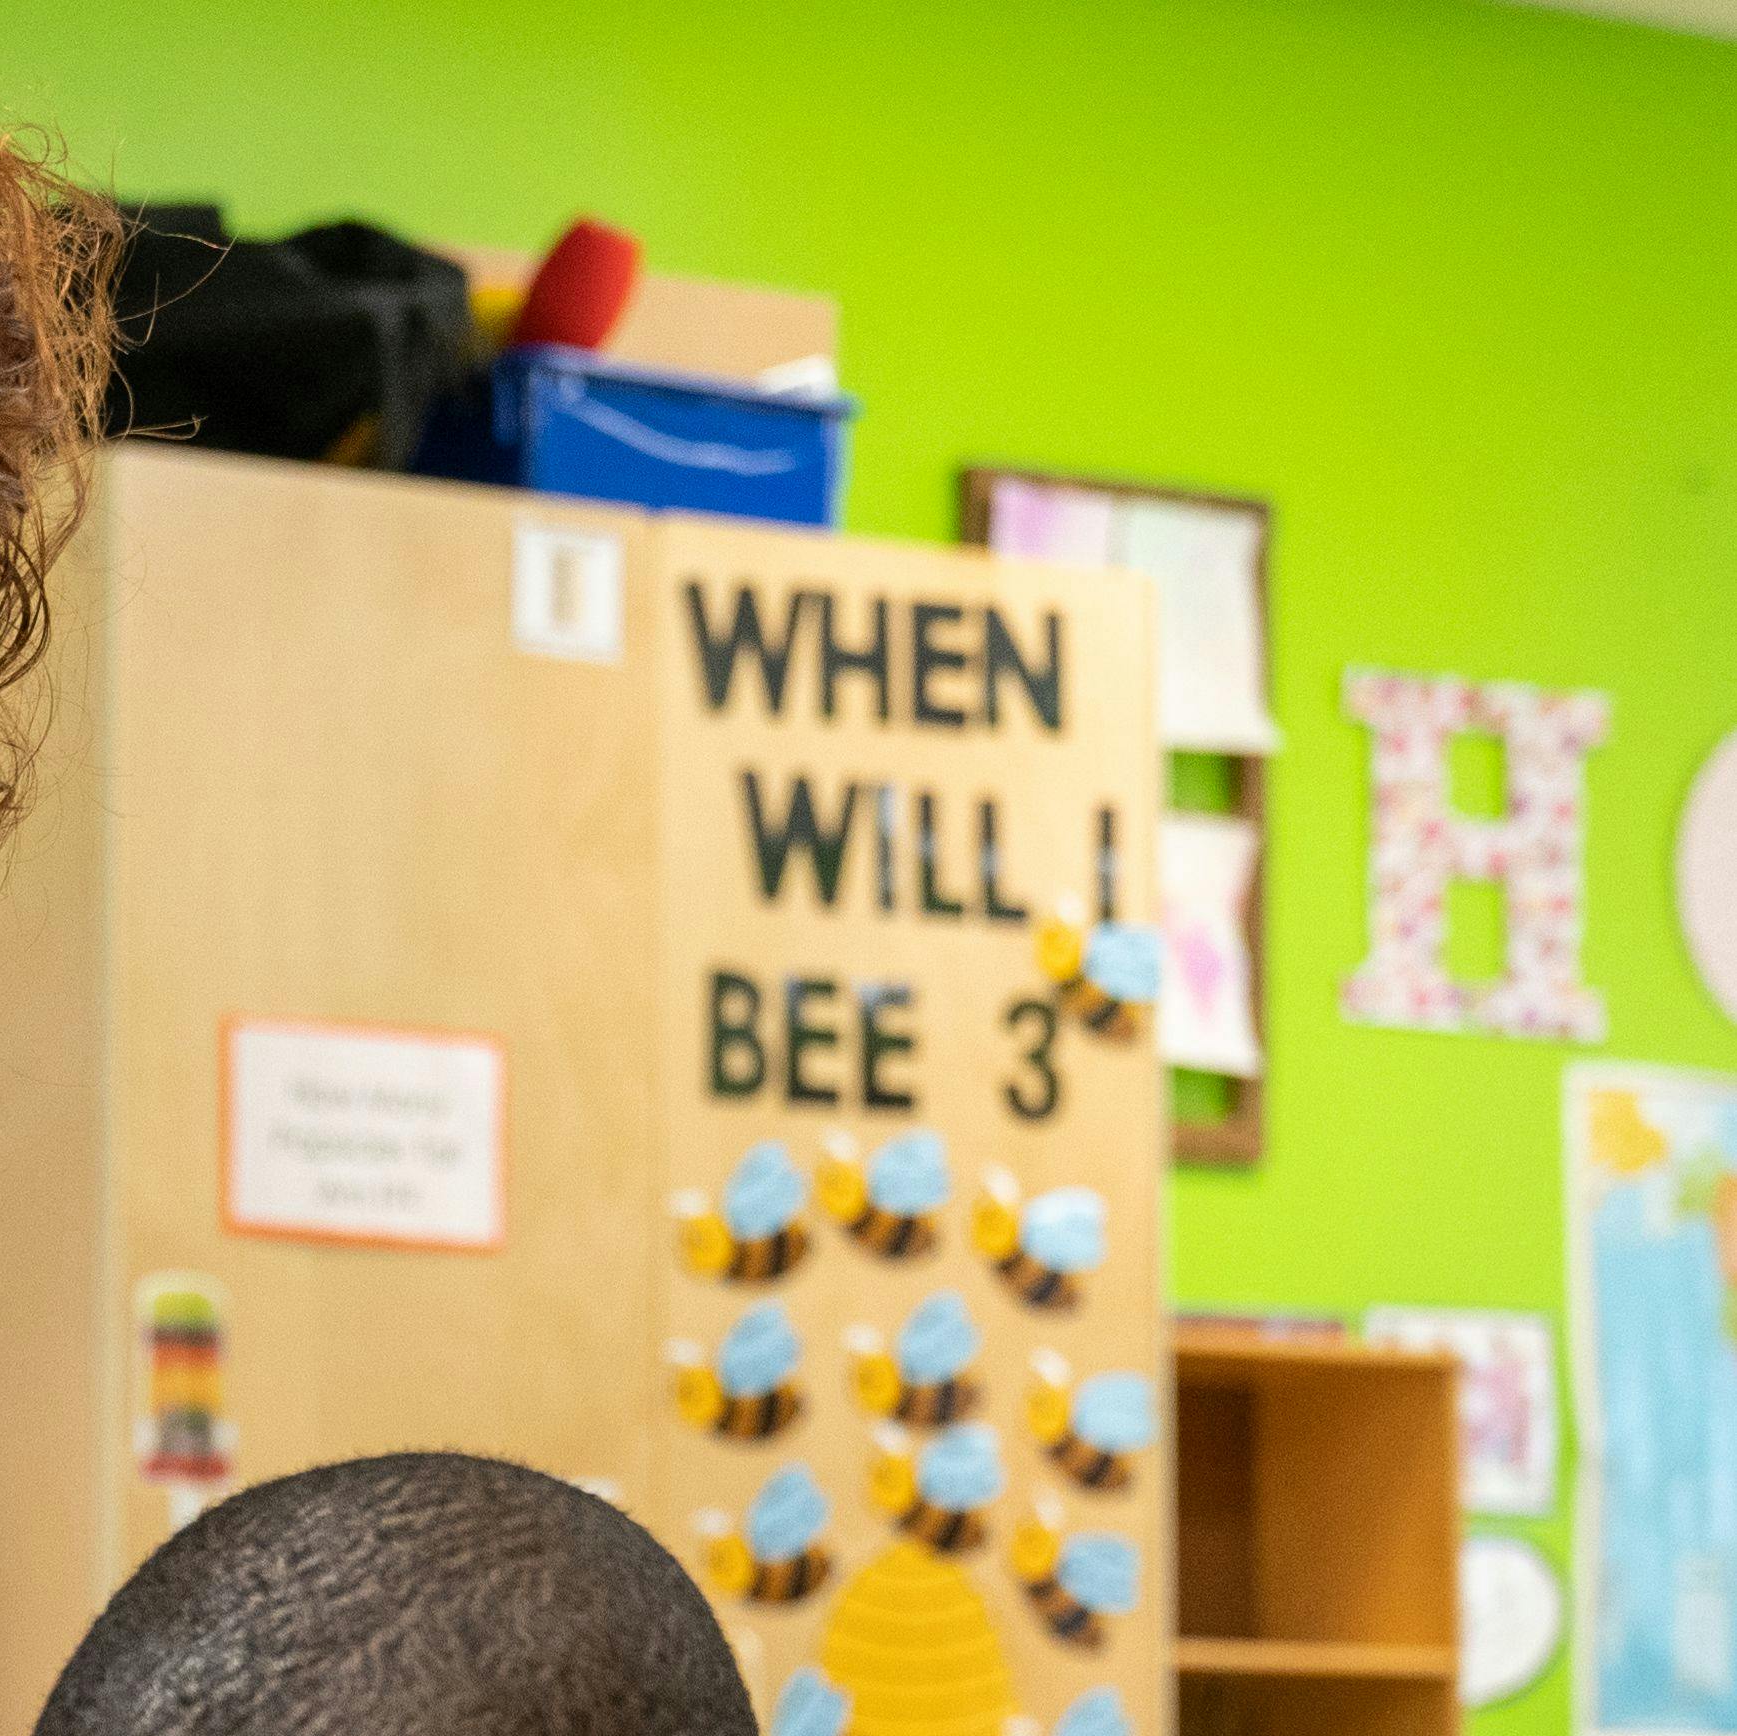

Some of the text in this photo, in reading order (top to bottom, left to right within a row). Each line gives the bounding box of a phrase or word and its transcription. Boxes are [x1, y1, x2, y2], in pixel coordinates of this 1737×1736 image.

[685, 580, 1063, 731] WHEN
[742, 771, 1028, 920] WILL
[711, 971, 1060, 1121] BEE 3
